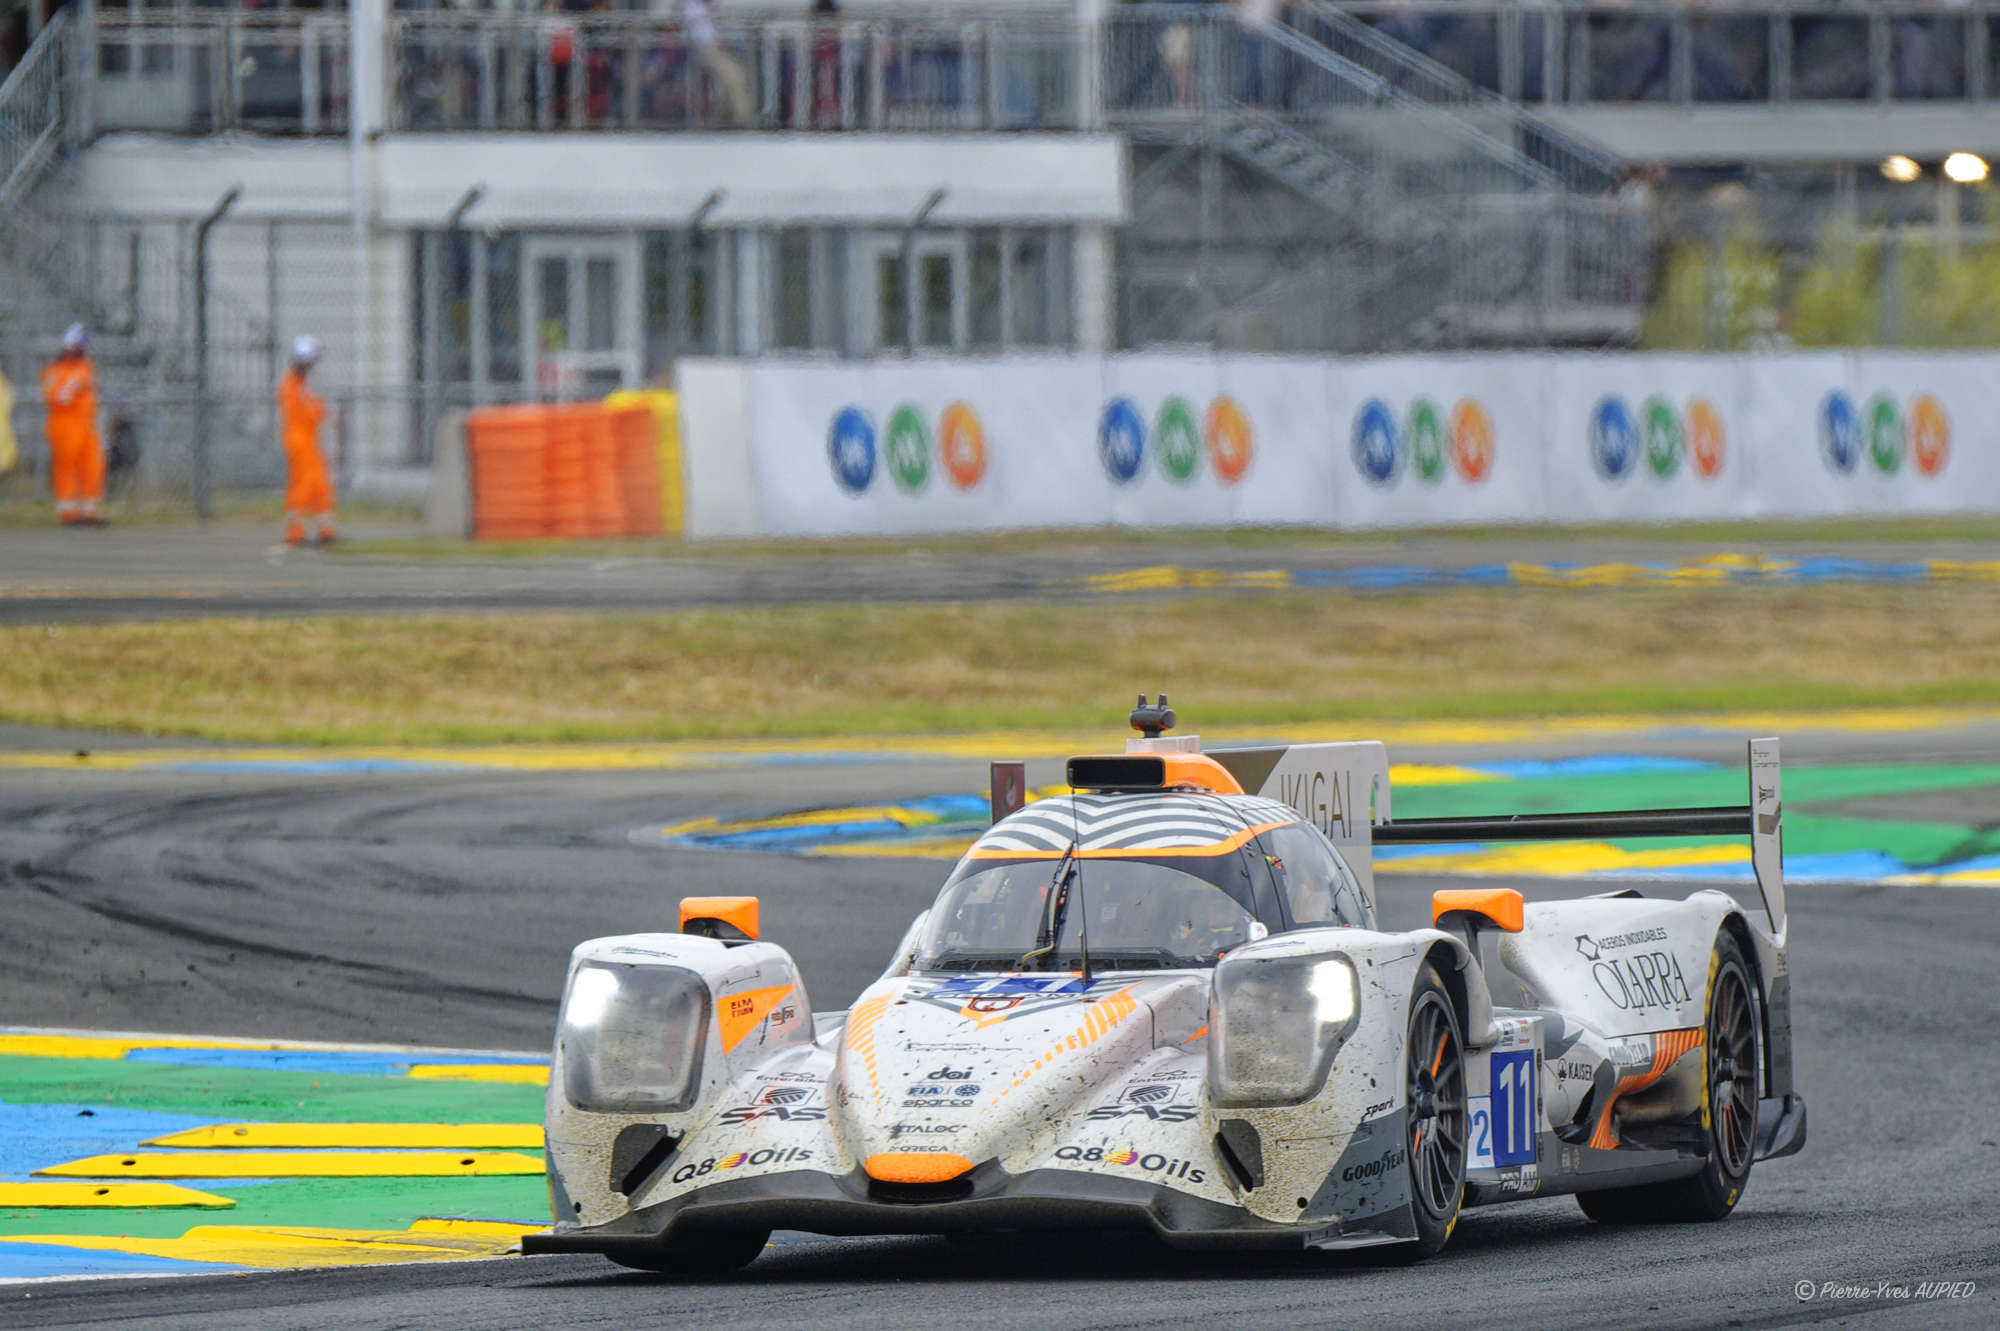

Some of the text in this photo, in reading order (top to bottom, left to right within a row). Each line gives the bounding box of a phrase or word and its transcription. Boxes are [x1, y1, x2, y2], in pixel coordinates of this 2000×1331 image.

[1567, 1061, 1593, 1082] KAISER
[907, 1086, 942, 1096] FIA
[902, 1098, 975, 1107] sparco
[1499, 1060, 1531, 1154] 11
[717, 1106, 831, 1126] SAS
[1085, 1104, 1199, 1122] SAS
[673, 1146, 814, 1184] Q8 Oils
[1054, 1145, 1207, 1184] Q8 Oils
